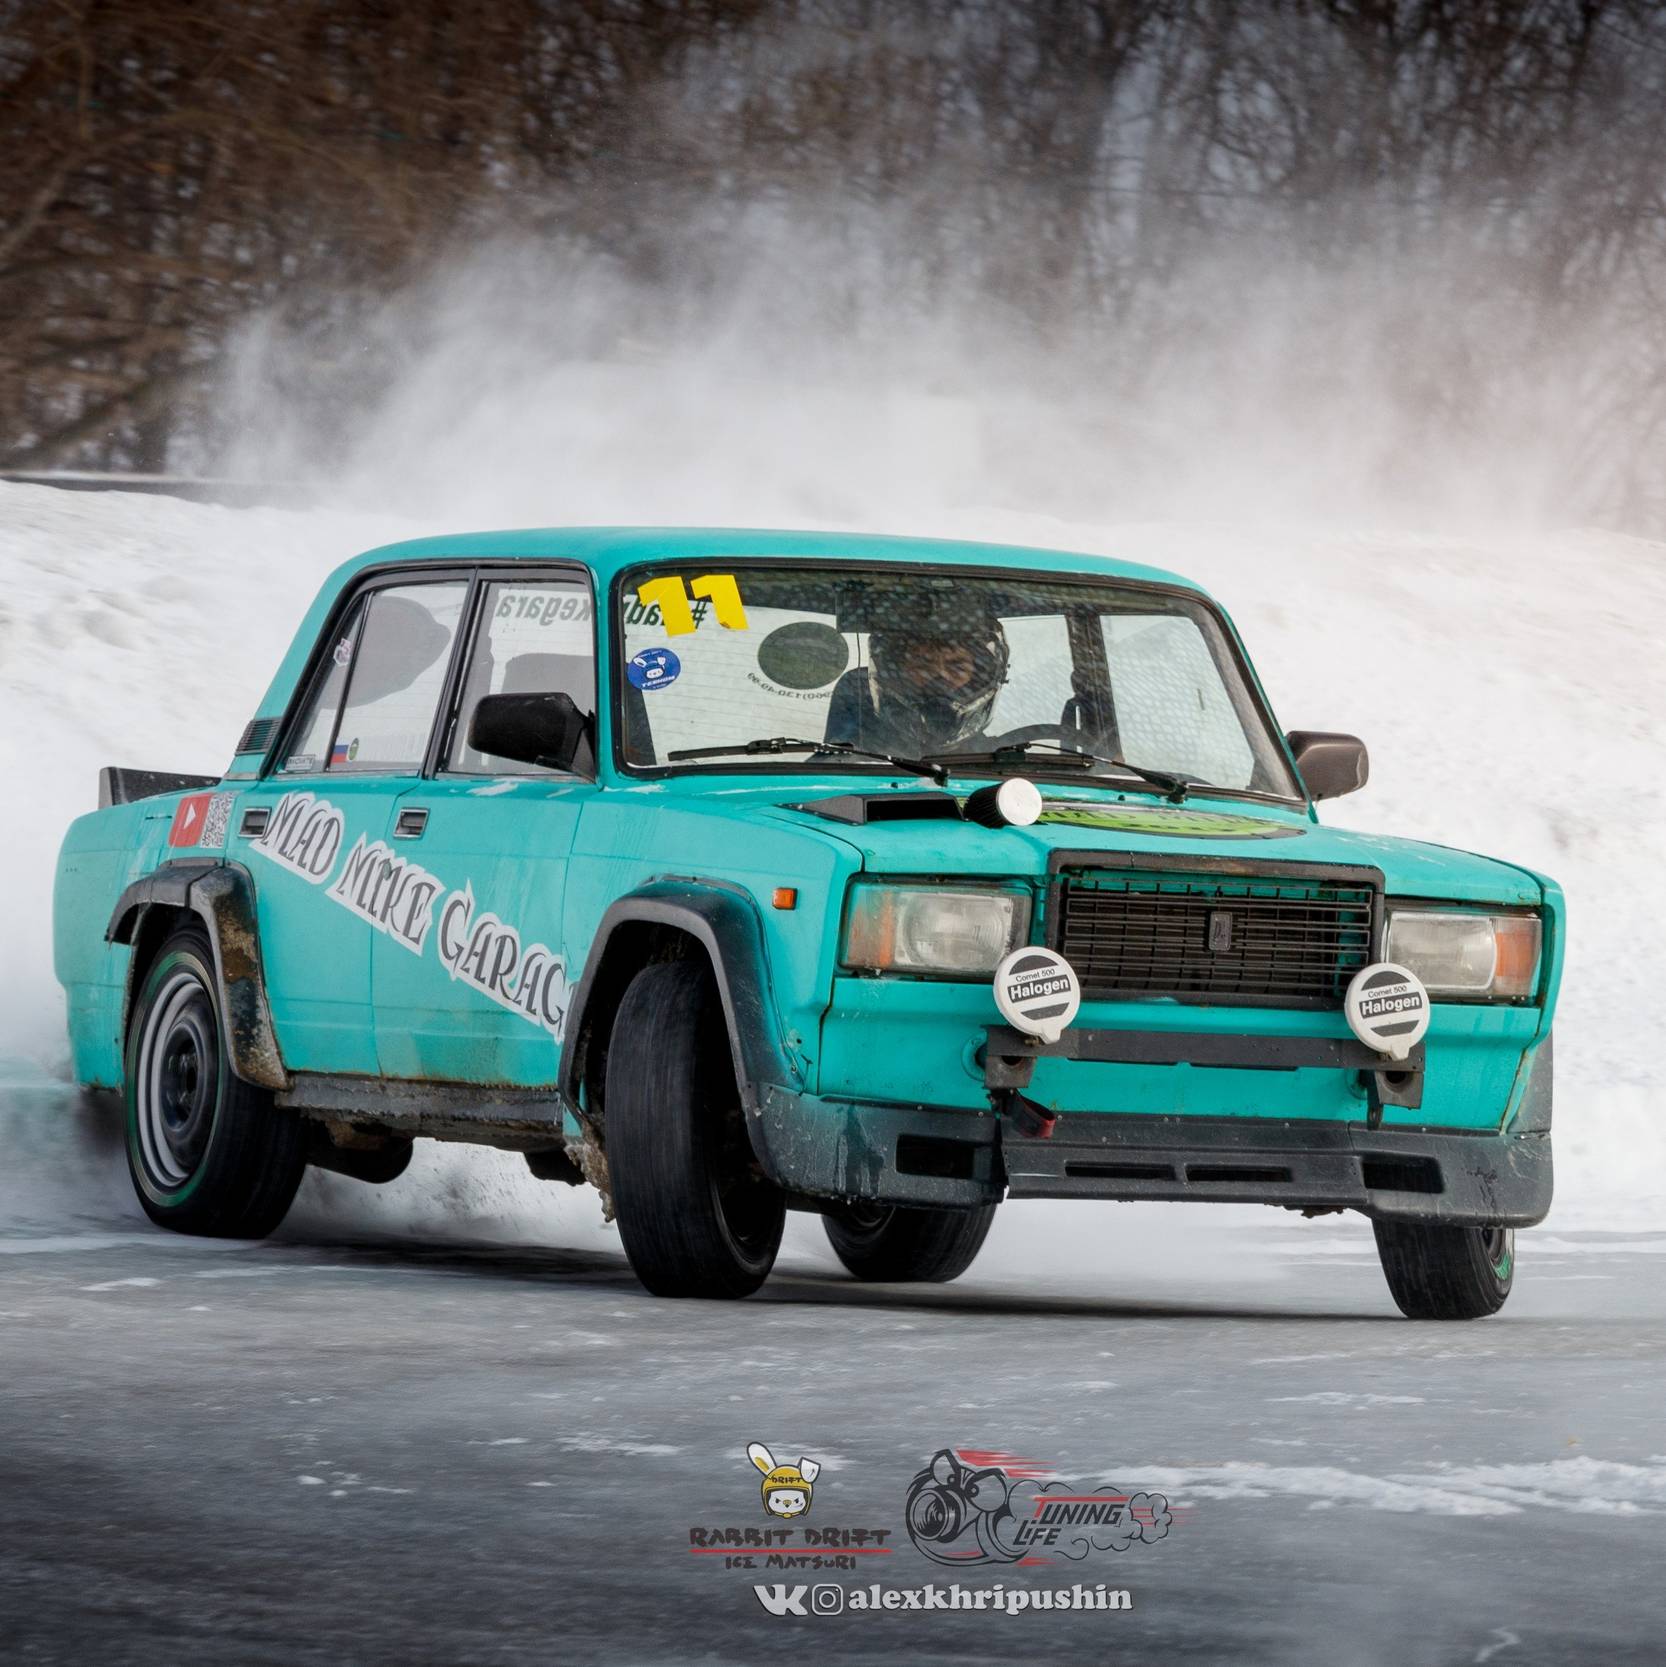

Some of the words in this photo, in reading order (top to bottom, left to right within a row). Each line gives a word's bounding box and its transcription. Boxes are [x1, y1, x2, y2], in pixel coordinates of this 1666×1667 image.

[637, 575, 749, 637] 11
[262, 795, 341, 877] MAD
[336, 846, 438, 944] MIKE
[441, 896, 573, 1036] GARAG
[1016, 972, 1040, 983] Comet
[1041, 968, 1056, 977] 500
[1010, 979, 1069, 1000] Halogen
[1368, 989, 1392, 998] Comet
[1393, 985, 1407, 993] 500
[1362, 996, 1420, 1016] Halogen
